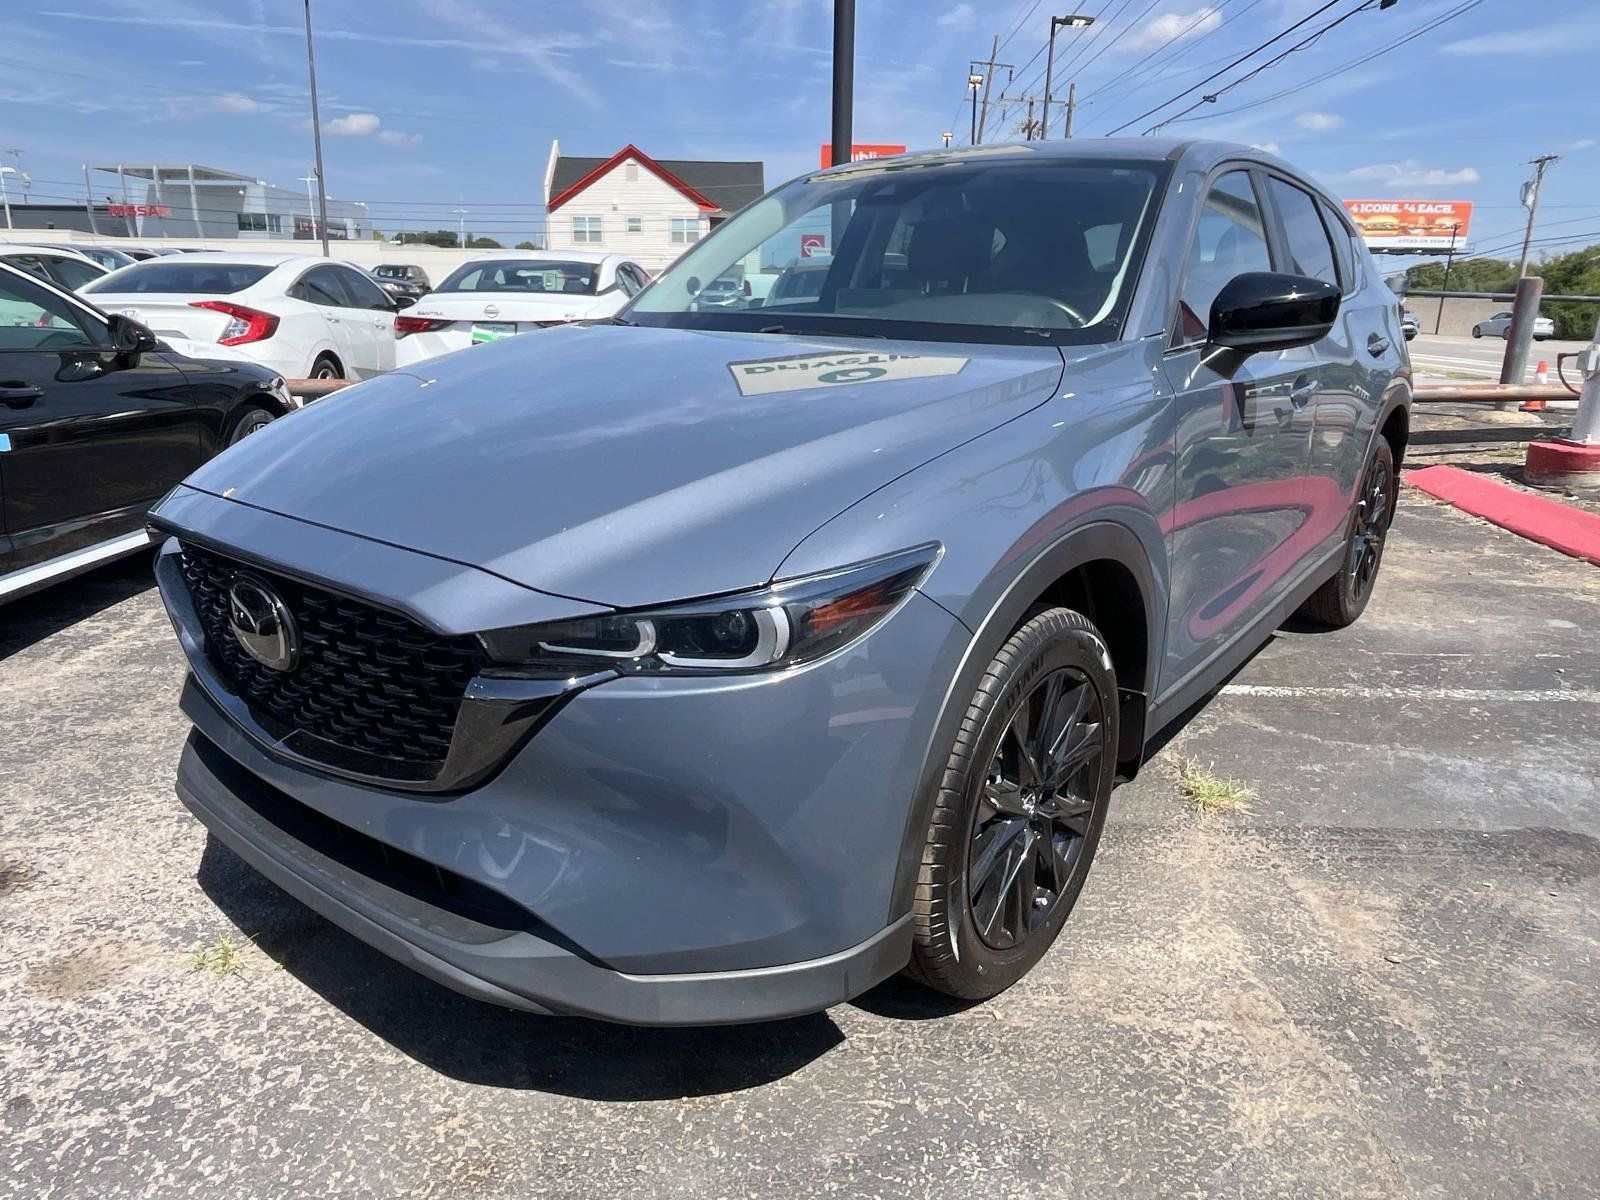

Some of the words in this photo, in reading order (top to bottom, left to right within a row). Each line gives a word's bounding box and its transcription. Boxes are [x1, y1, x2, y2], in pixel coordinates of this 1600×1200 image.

[1350, 203, 1359, 213] 4
[1360, 203, 1402, 214] ICONS.
[1418, 204, 1456, 214] EACH.
